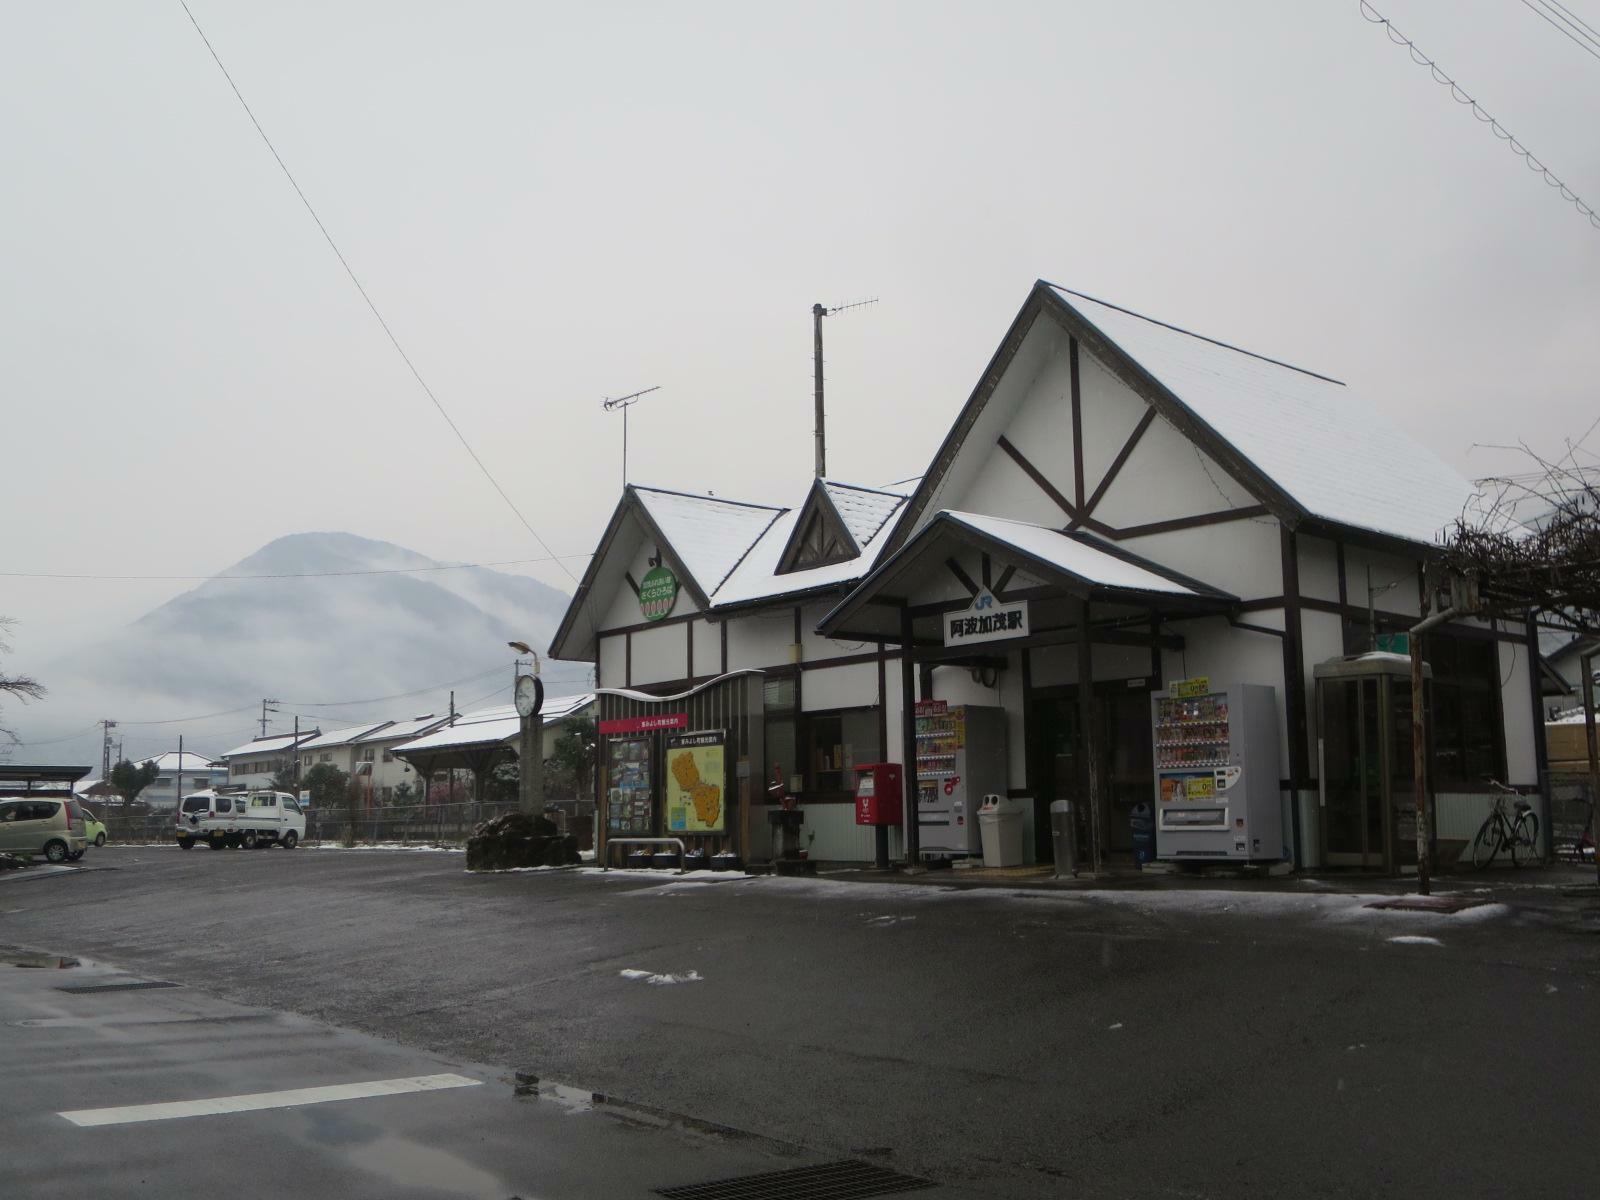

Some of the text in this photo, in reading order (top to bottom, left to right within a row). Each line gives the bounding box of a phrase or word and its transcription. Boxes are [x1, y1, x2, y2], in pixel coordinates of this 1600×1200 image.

[974, 595, 993, 610] JR
[950, 610, 1023, 639] 阿波加茂駅
